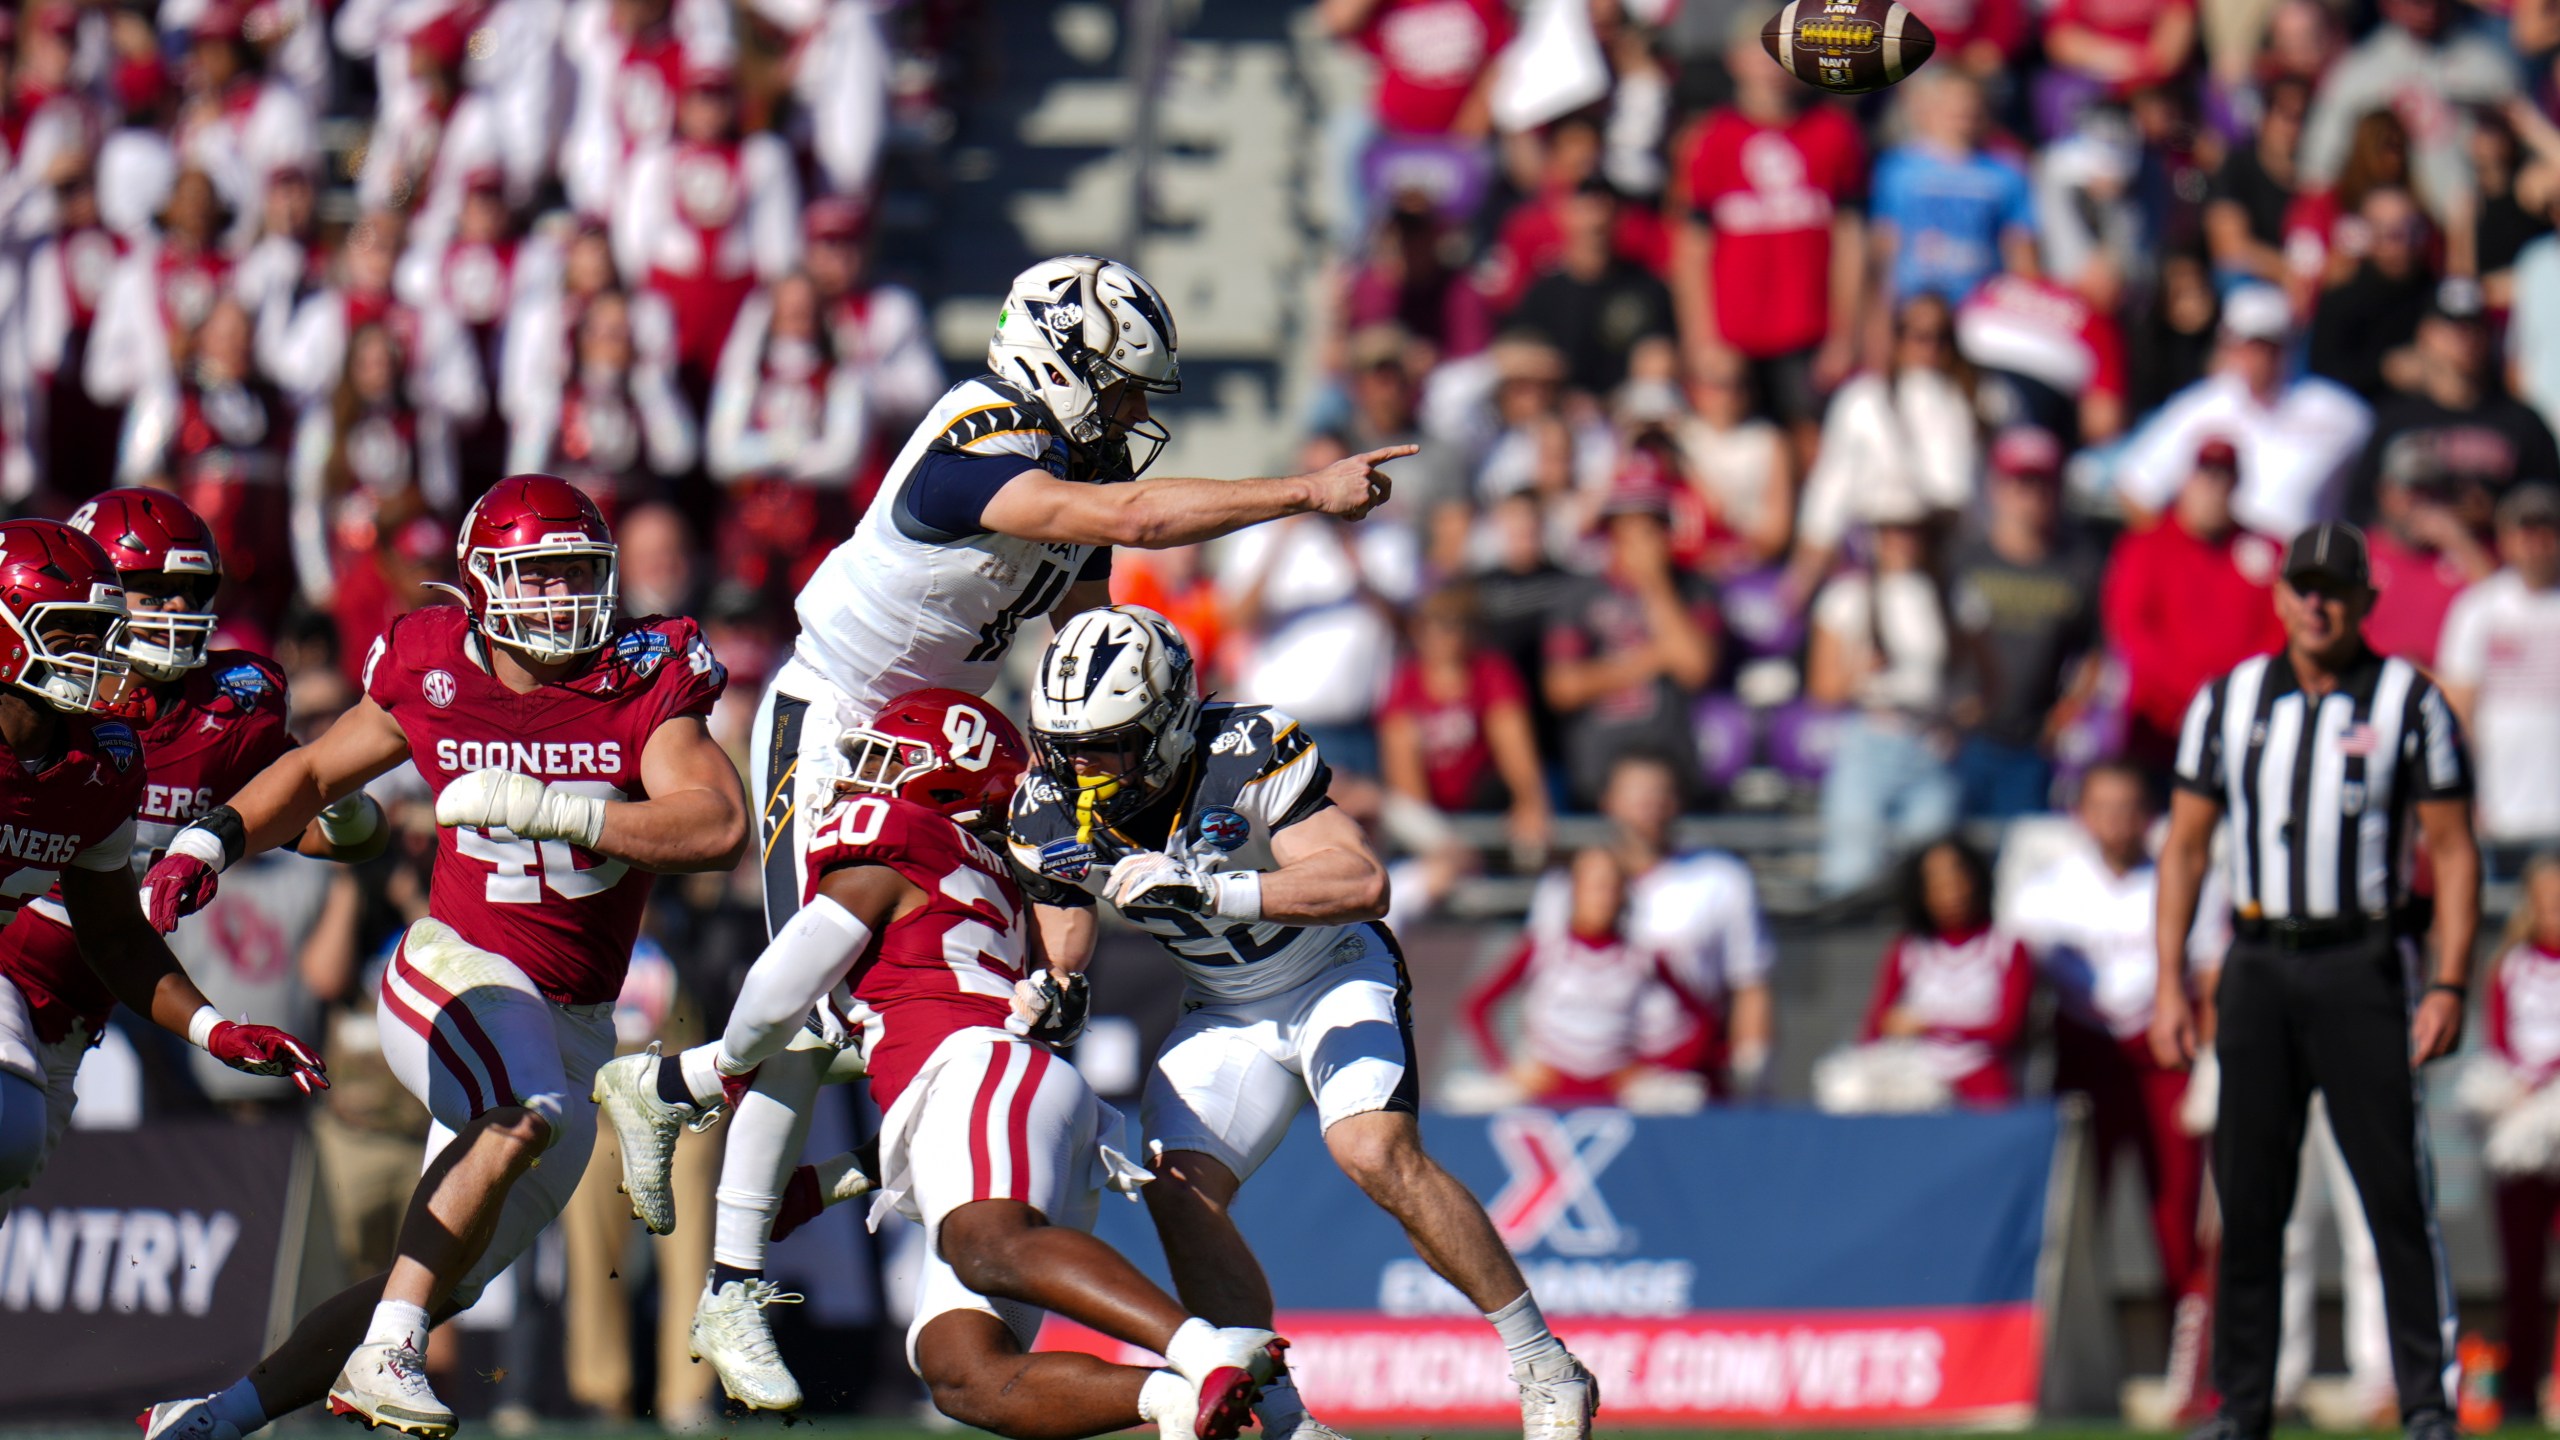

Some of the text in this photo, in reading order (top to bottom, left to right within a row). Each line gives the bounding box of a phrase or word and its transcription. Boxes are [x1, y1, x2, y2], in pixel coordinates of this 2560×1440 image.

[1823, 4, 1858, 14] NAVY
[1818, 57, 1852, 68] NAVY
[963, 559, 1070, 662] 11
[425, 672, 454, 706] SEC
[942, 703, 997, 773] OU
[1051, 718, 1079, 730] NAVY
[436, 738, 622, 775] SOONERS
[455, 780, 632, 904] 40
[809, 796, 891, 853] 20
[0, 1206, 241, 1318] NTRY
